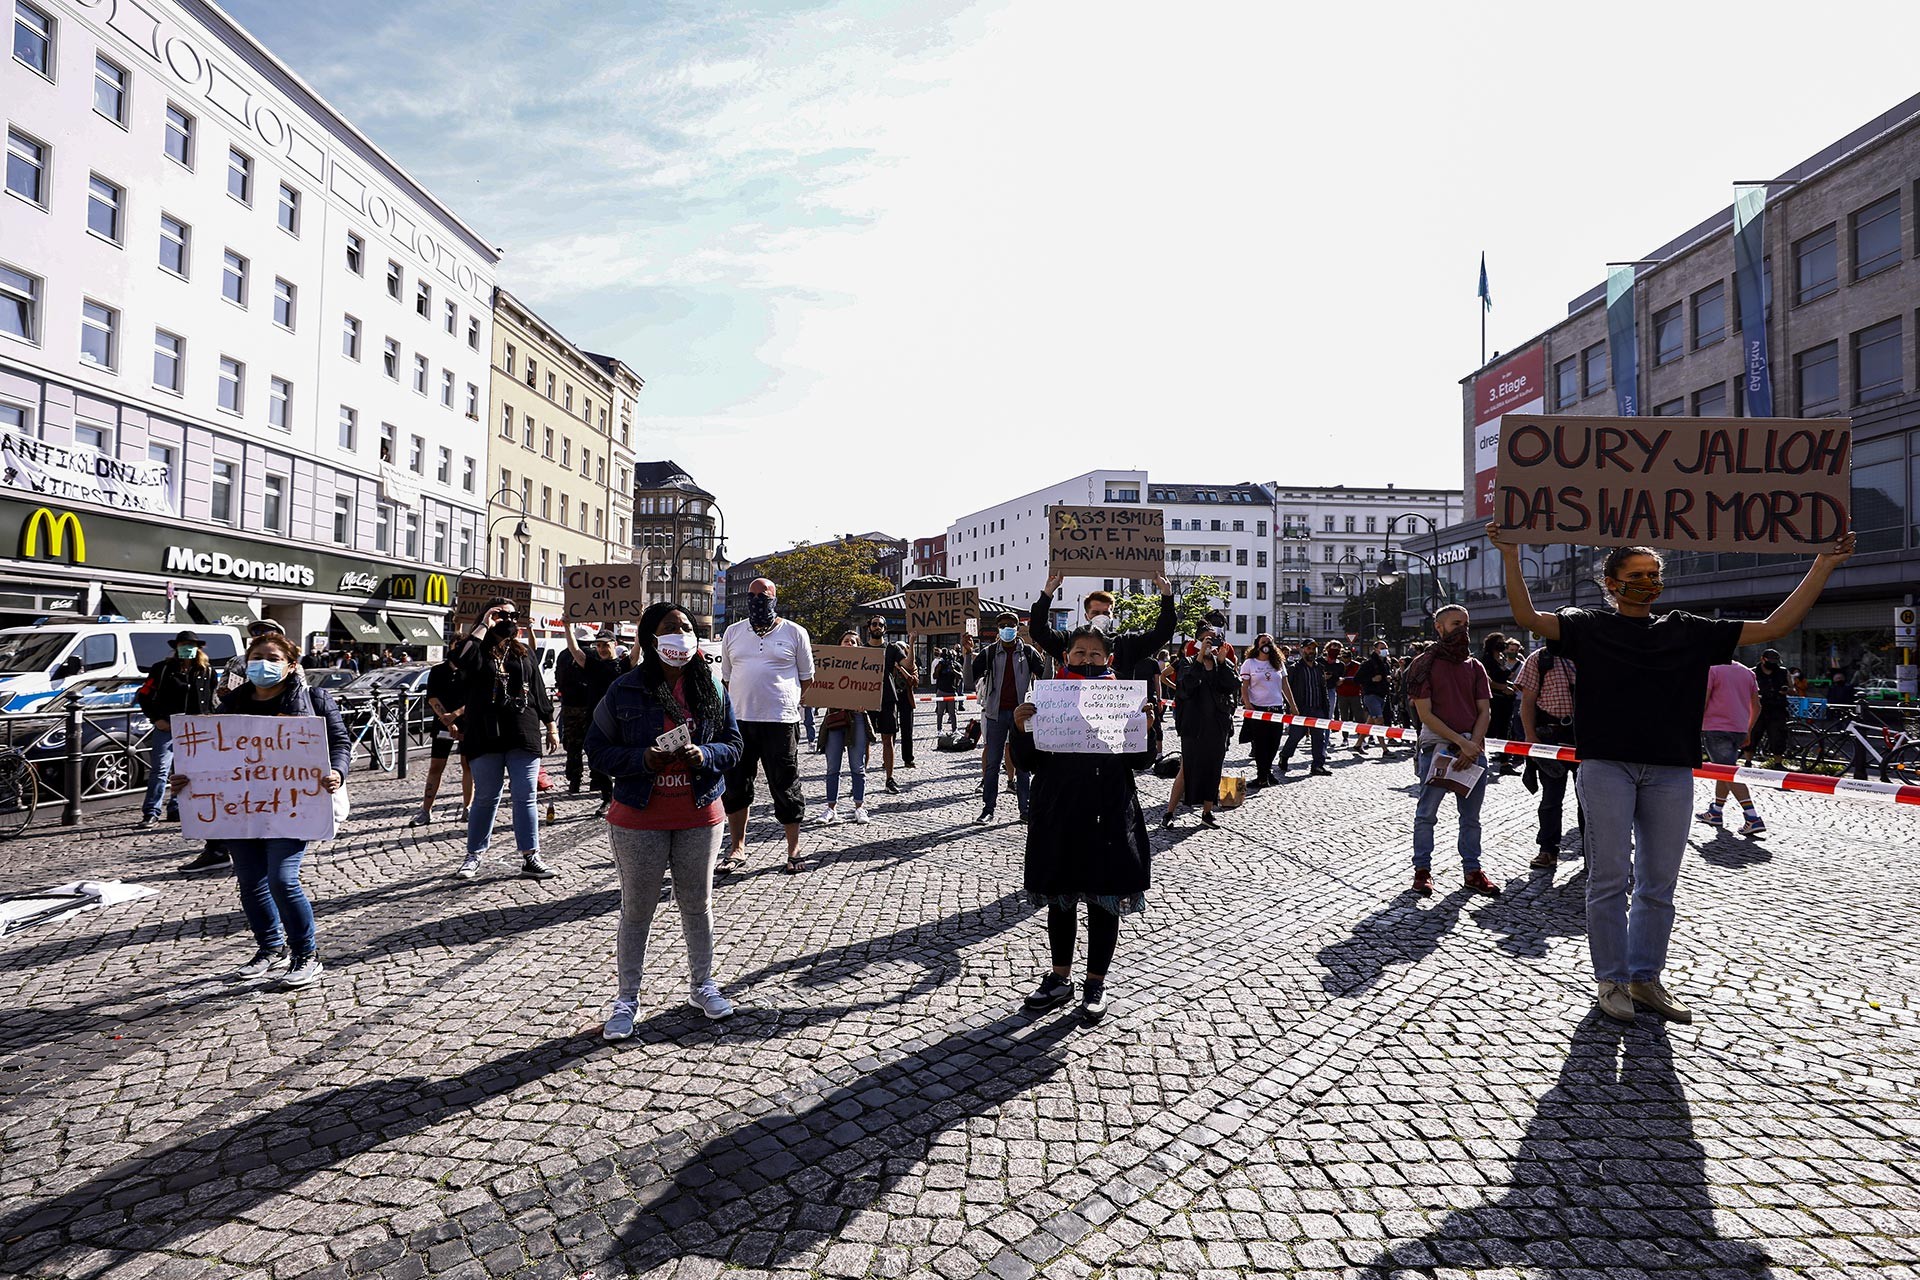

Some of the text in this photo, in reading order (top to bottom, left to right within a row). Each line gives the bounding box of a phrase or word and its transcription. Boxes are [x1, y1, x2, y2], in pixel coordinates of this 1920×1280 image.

[1499, 375, 1527, 398] Etage
[1507, 425, 1850, 476] OURY JALLOH
[1500, 486, 1847, 544] DAS WAR MORD
[166, 546, 315, 587] McDonald's
[568, 571, 632, 589] Close
[592, 589, 610, 600] all
[908, 590, 976, 610] SAY THEIR
[569, 600, 641, 618] CAMPS
[911, 608, 976, 628] NAMES
[810, 680, 835, 690] muz
[231, 765, 322, 797] sierung
[191, 787, 298, 823] Jetzt!
